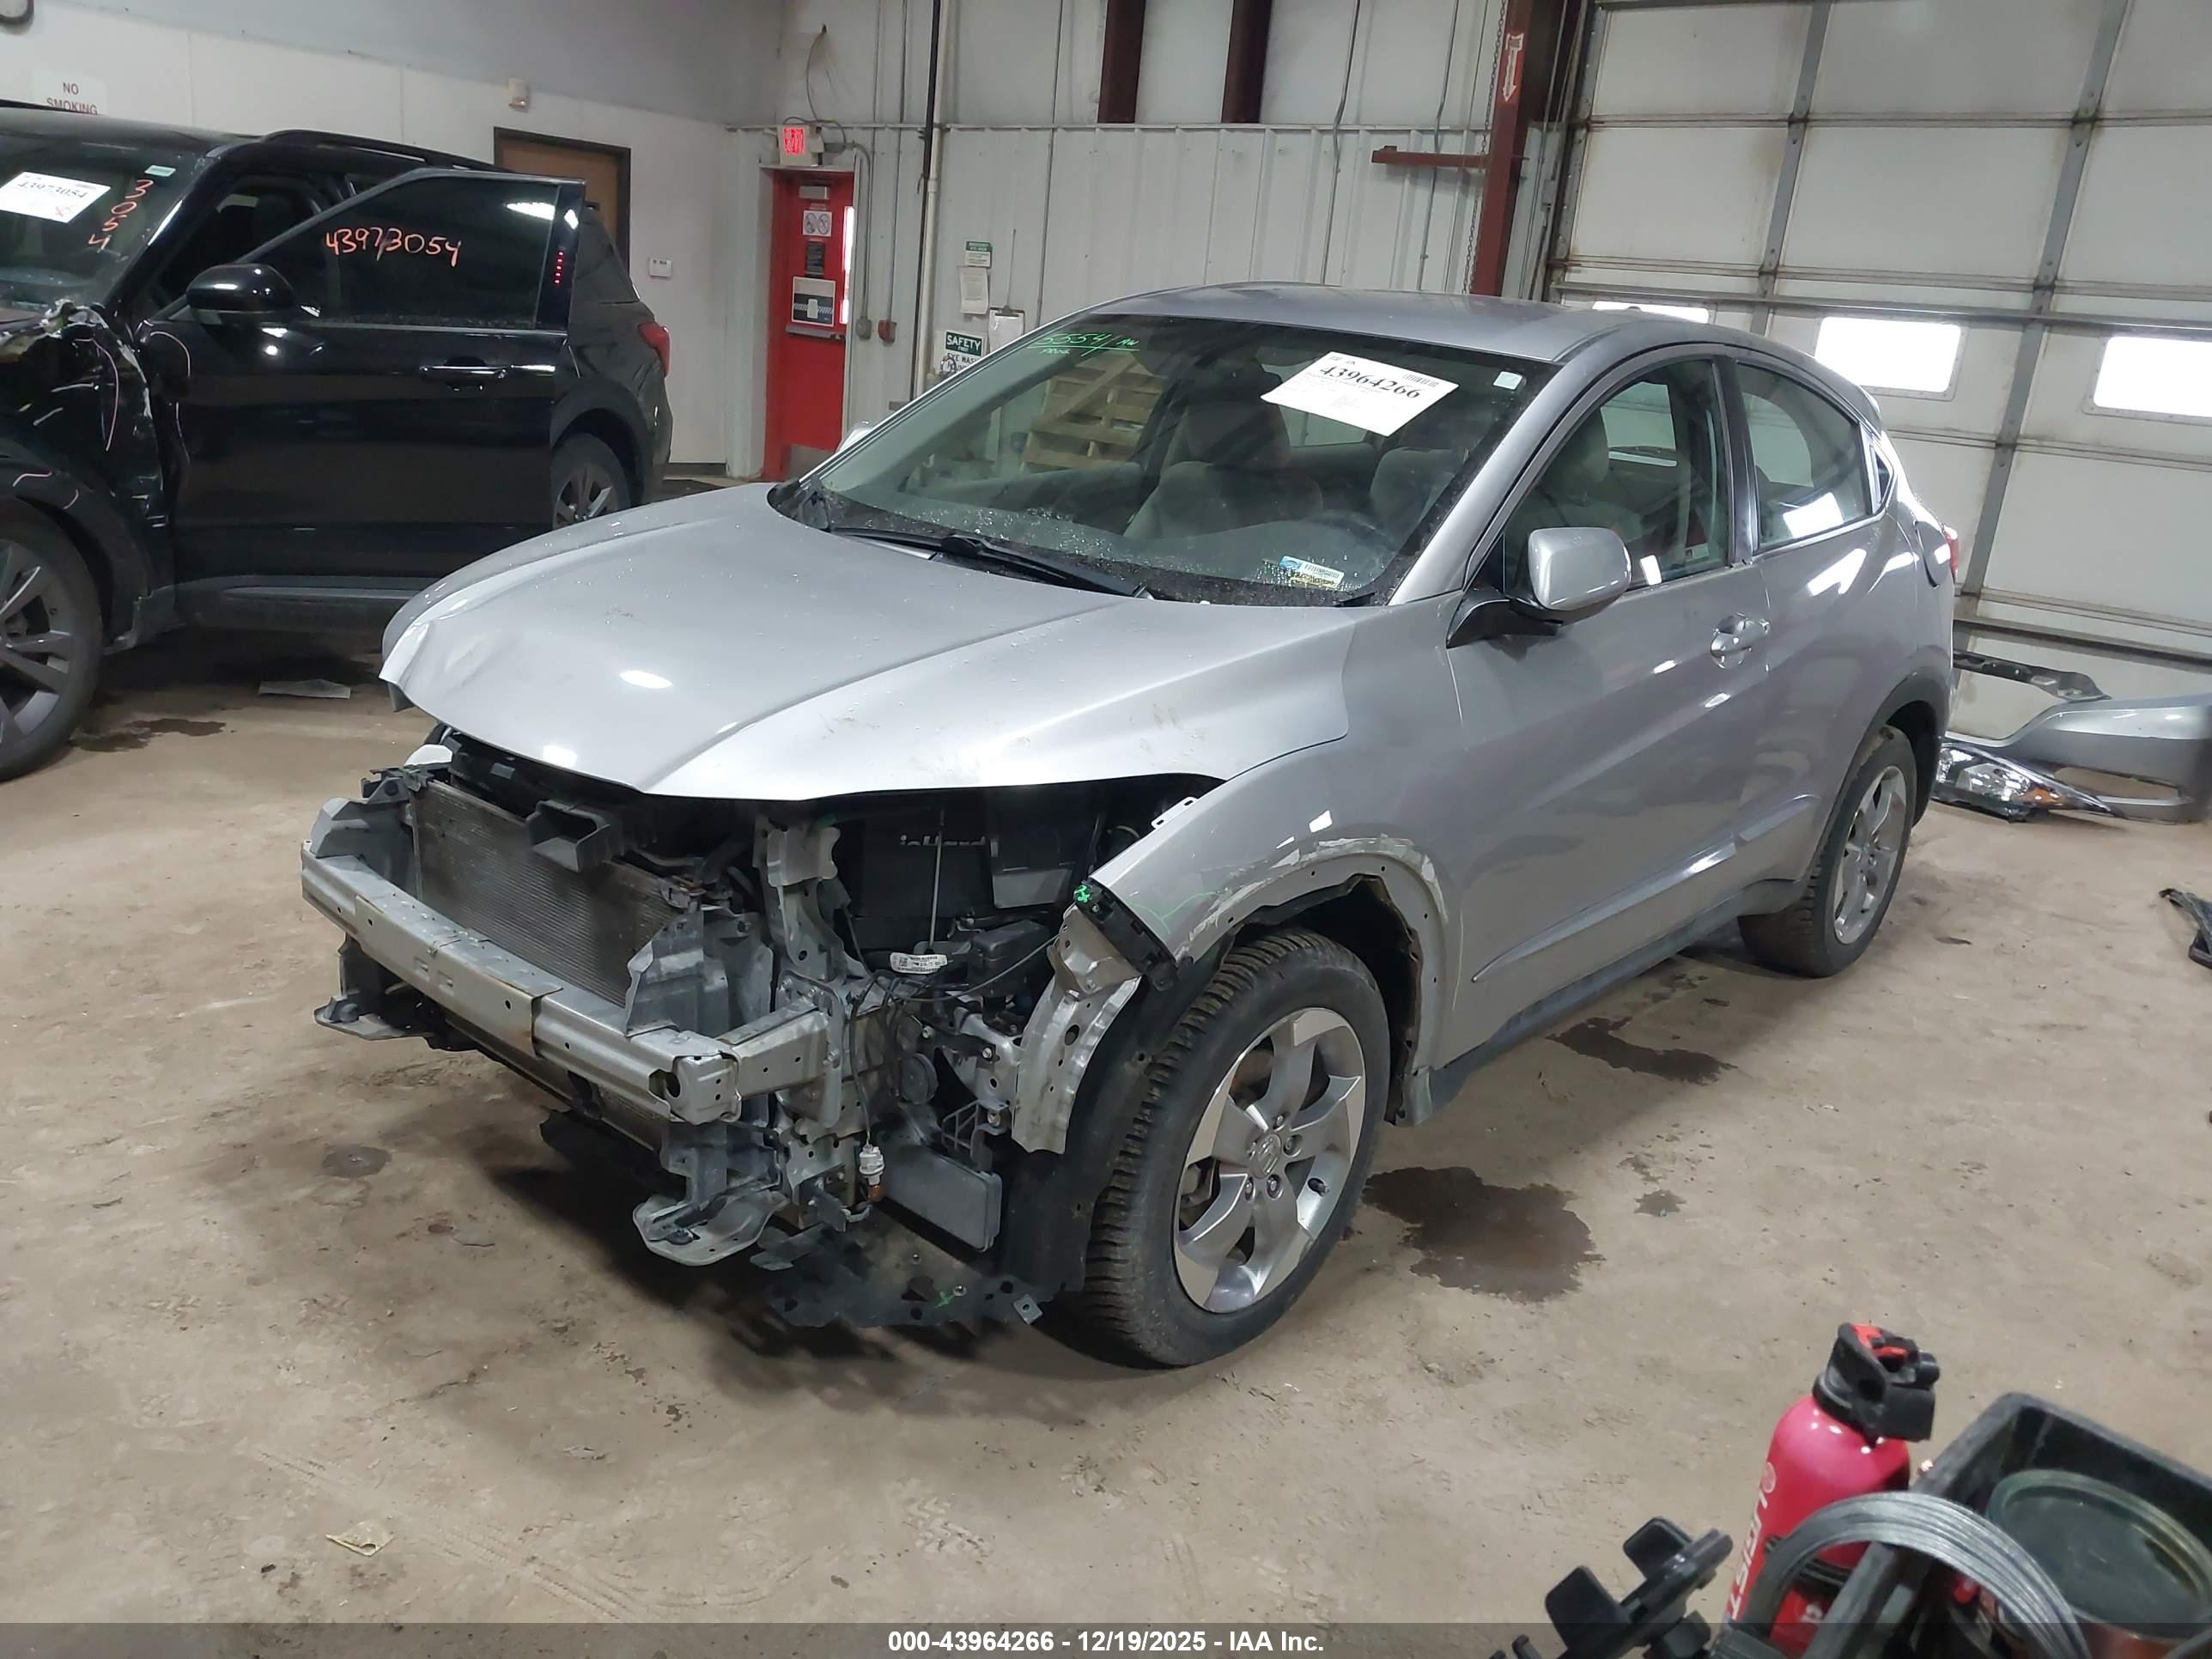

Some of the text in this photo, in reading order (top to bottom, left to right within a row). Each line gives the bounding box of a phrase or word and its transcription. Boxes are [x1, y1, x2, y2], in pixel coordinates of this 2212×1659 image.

[63, 82, 79, 95] NO
[46, 97, 98, 115] SMOKING
[325, 227, 462, 268] 43973054
[946, 334, 981, 351] SAFETY
[1319, 365, 1421, 399] 43964266
